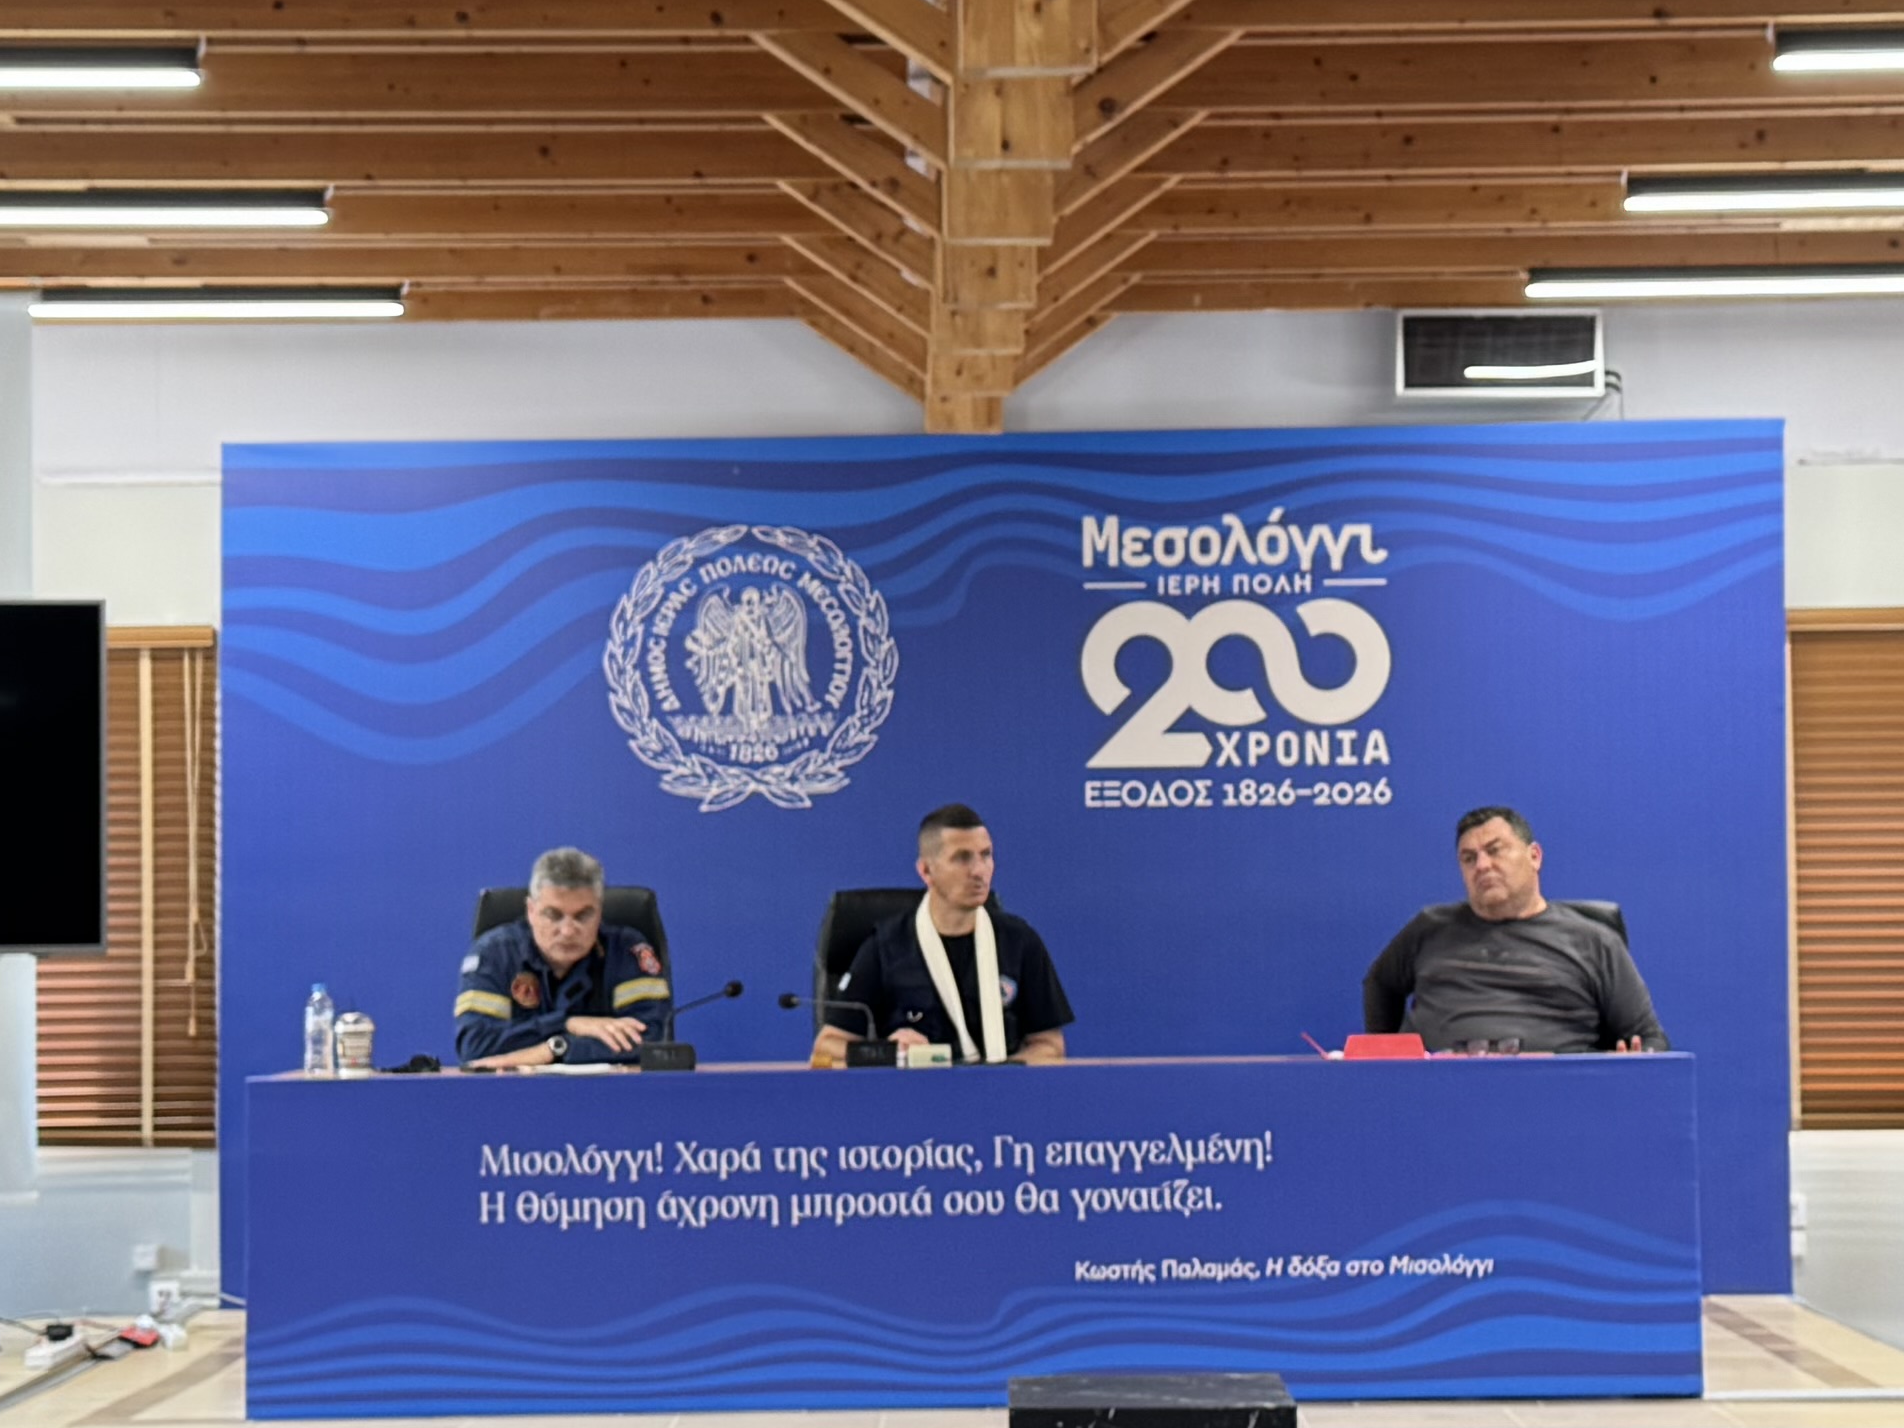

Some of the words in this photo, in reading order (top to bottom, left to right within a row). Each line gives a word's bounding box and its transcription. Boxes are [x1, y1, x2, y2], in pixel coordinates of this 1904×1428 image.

[1082, 507, 1389, 571] Μεσολόγγι
[1157, 574, 1221, 596] ΙΕΡΗ
[1232, 573, 1313, 595] ΠΟΛΗ
[1215, 729, 1390, 768] ΧΡΟΝΙΑ
[1084, 779, 1214, 808] ΕΞΟΔΟΣ
[479, 1142, 664, 1183] Μισολόγγι!
[674, 1141, 762, 1181] Χαρά
[773, 1146, 829, 1180] της
[839, 1138, 983, 1177] ιστορίας,
[994, 1135, 1035, 1175] Γη
[1045, 1131, 1273, 1174] επαγγελμένη!
[479, 1191, 505, 1224] Η
[656, 1190, 780, 1229] άχρονη
[790, 1185, 932, 1227] μπροστά
[943, 1190, 1005, 1215] σου
[1014, 1181, 1060, 1214] θα
[1070, 1178, 1223, 1221] γονατίζει.
[1074, 1259, 1156, 1284] Κωστής
[1162, 1257, 1261, 1282] Παλαμάς,
[1265, 1257, 1284, 1277] Η
[1287, 1255, 1341, 1279] δόξα
[1345, 1259, 1385, 1277] στο
[1388, 1254, 1494, 1279] Μισολόγγι
